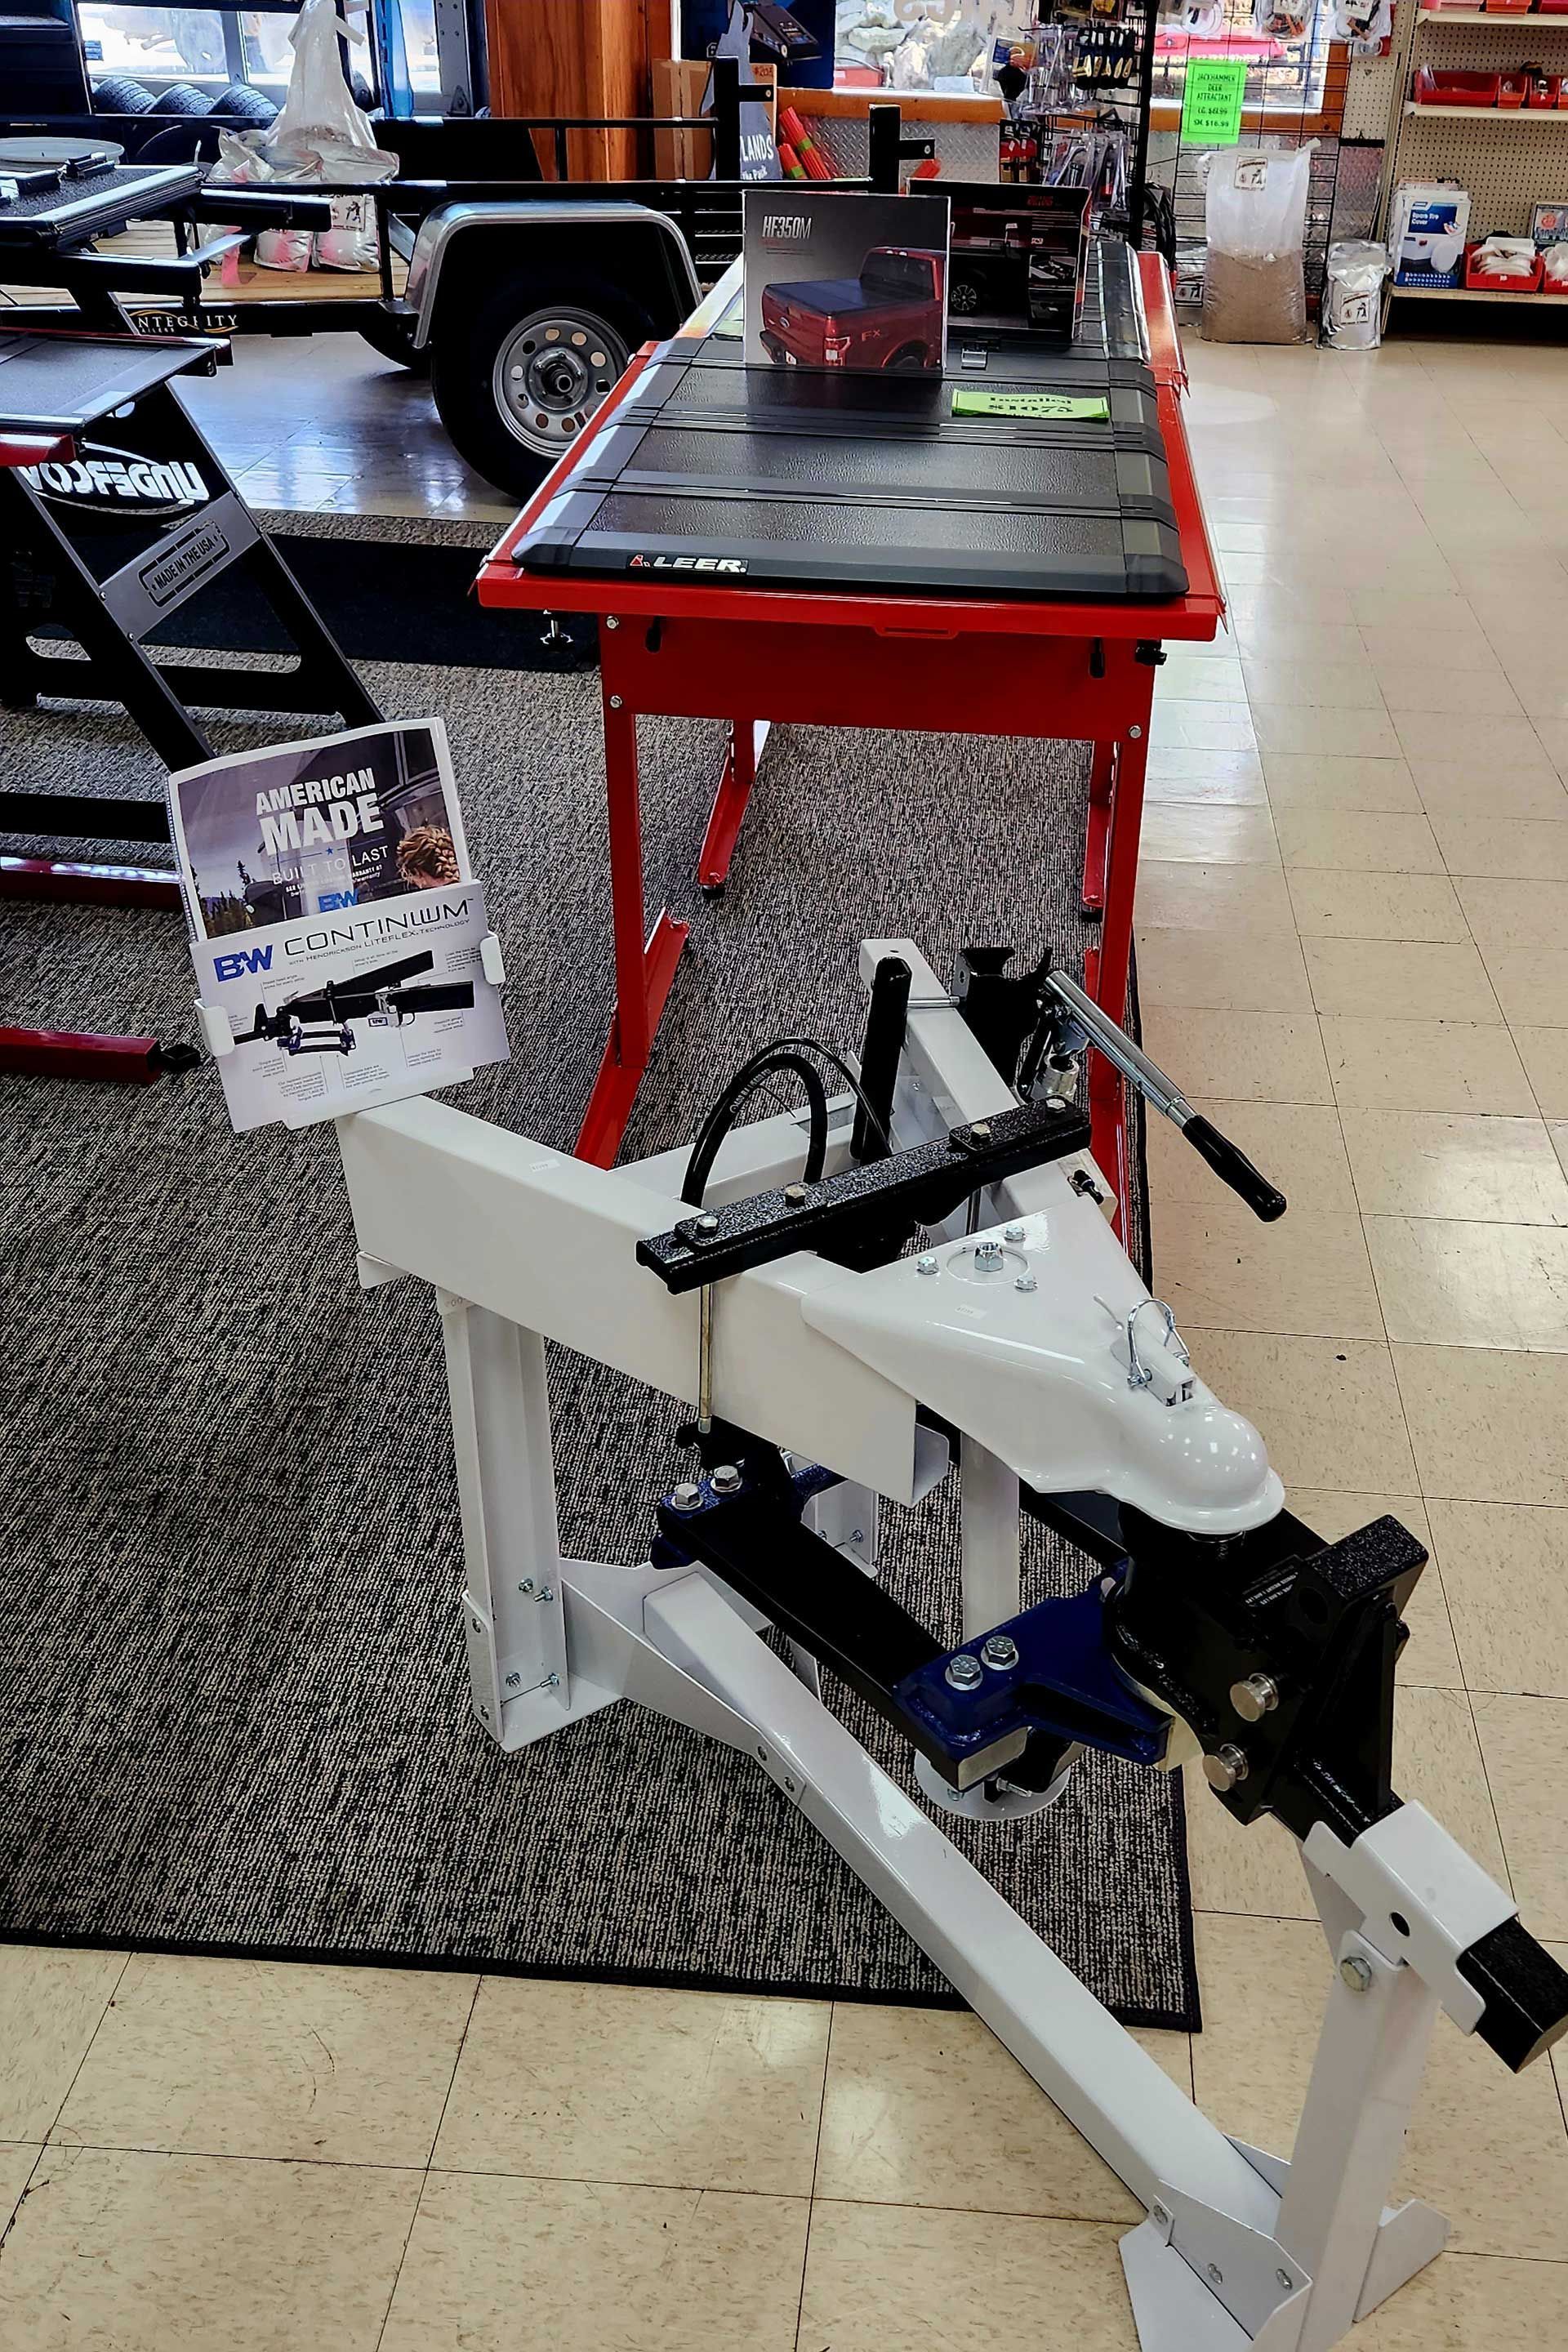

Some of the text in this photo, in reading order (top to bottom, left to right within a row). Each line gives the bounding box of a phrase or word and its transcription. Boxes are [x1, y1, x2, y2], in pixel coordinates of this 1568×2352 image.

[1196, 92, 1232, 102] ATTRACTANT
[762, 216, 812, 239] HF350M
[138, 314, 237, 328] NTEGITY
[154, 537, 216, 590] MADE IN THE USA
[653, 556, 742, 573] LEER
[256, 768, 376, 816] AMERICAN
[259, 792, 385, 857] MADE
[272, 863, 318, 885] BUILT
[323, 858, 346, 873] TO
[352, 845, 389, 867] LAST
